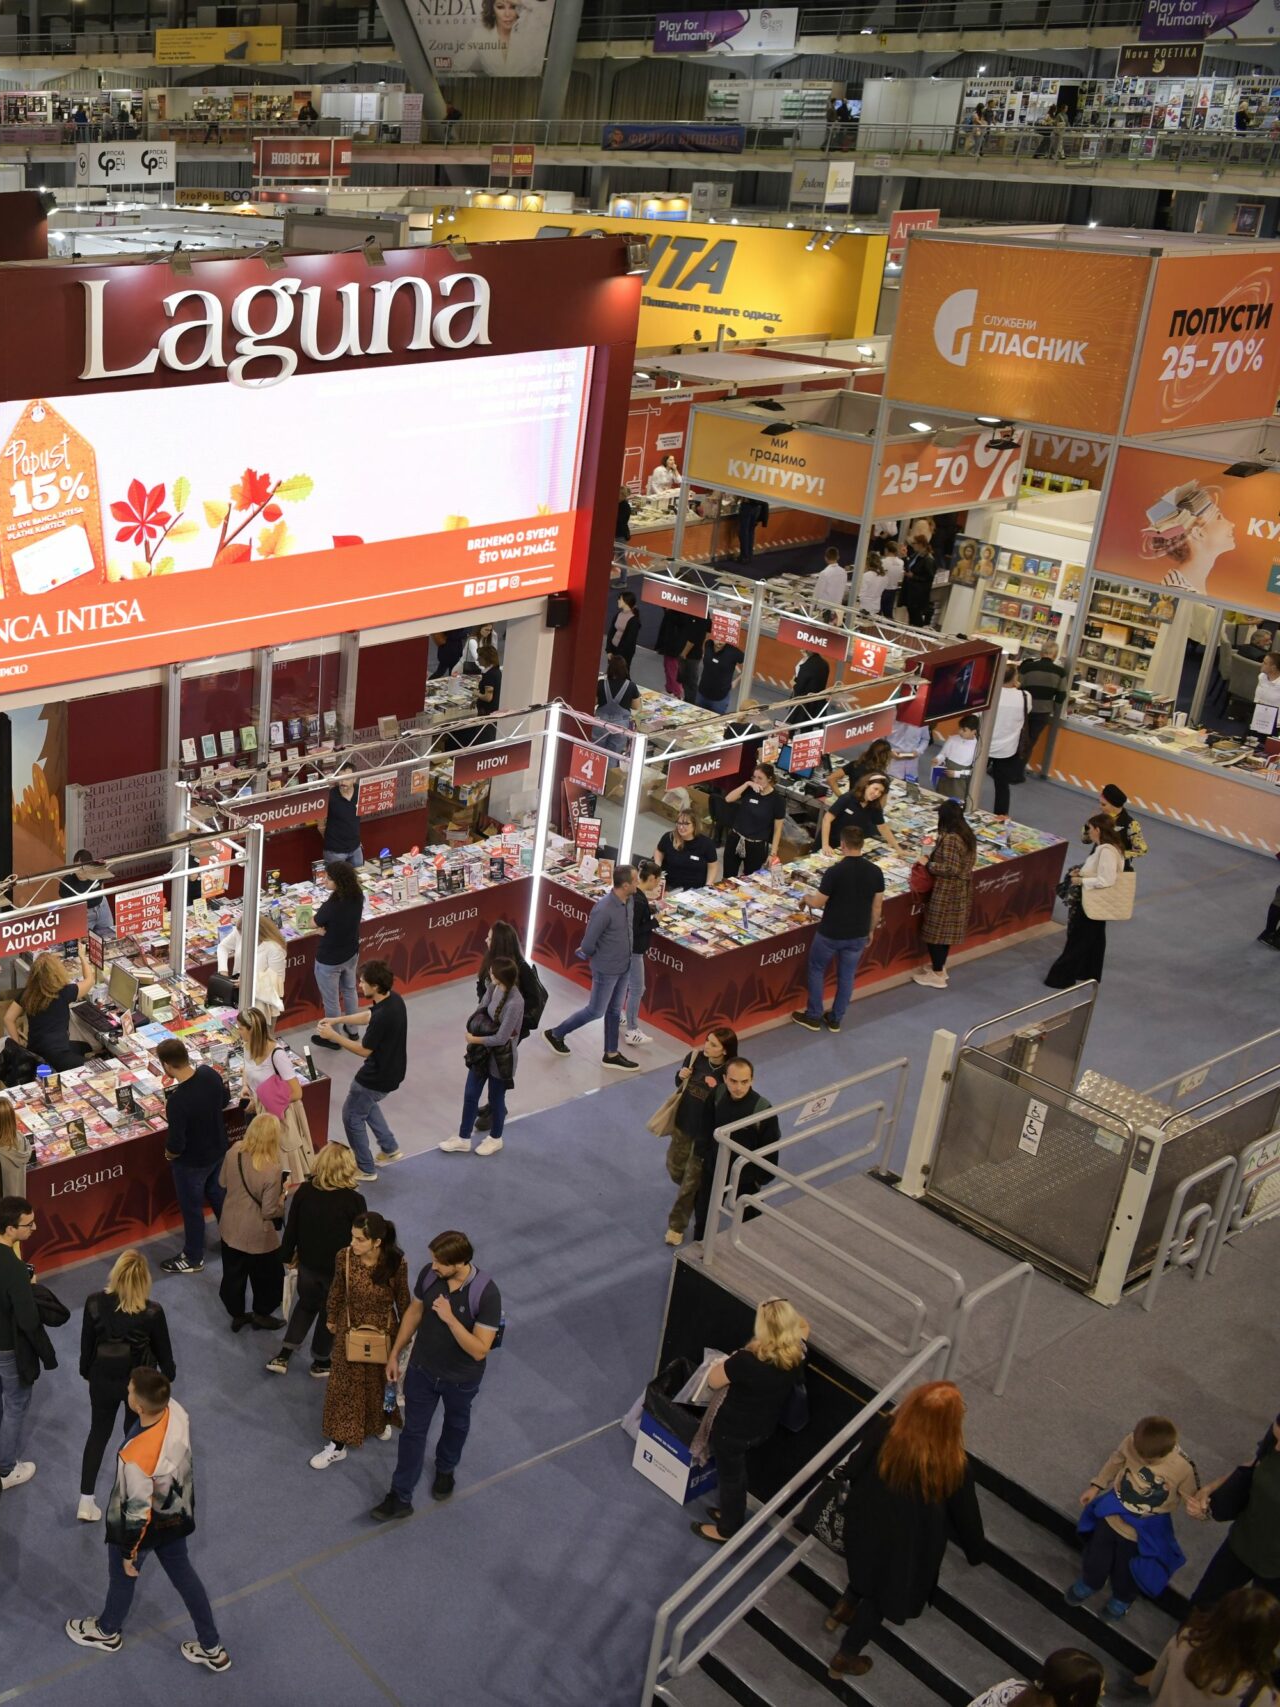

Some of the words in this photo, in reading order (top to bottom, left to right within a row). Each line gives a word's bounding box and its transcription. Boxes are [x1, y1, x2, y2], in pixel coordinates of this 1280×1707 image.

[659, 19, 681, 32] Play
[683, 19, 699, 30] for
[1156, 12, 1217, 28] Humanity
[666, 28, 716, 43] Humanity
[428, 39, 454, 51] Zora
[454, 40, 466, 54] je
[468, 39, 507, 50] svanula
[1125, 49, 1149, 60] Nova
[1153, 47, 1198, 59] POETIKA
[271, 152, 320, 165] НОВОСТИ
[180, 191, 220, 200] ProPolis
[742, 310, 783, 323] одмах.
[983, 314, 1037, 330] СЛУЖБЕНИ
[1168, 302, 1274, 338] ПОПУСТИ
[77, 272, 493, 389] Laguna
[978, 330, 1089, 366] ГЛАСНИК
[770, 437, 789, 450] ми
[4, 432, 71, 480] Popust
[750, 447, 807, 468] градимо
[727, 458, 826, 496] КУЛТУРУ!
[9, 471, 90, 518] 15%
[33, 515, 58, 526] BANCA
[467, 533, 515, 551] BRINEMO
[516, 531, 525, 542] O
[525, 525, 559, 542] SVEMU
[478, 546, 499, 564] ŠTO
[499, 546, 521, 561] VAM
[661, 590, 689, 606] DRAME
[56, 598, 146, 636] INTESA
[796, 630, 829, 648] DRAME
[861, 650, 875, 668] 3
[845, 722, 875, 739] DRAME
[476, 754, 509, 772] HITOVI
[578, 749, 601, 761] KASA
[580, 759, 594, 780] 4
[689, 757, 722, 777] DRAME
[380, 779, 395, 790] 10%
[379, 791, 394, 800] 15%
[377, 801, 393, 811] 20%
[141, 893, 161, 906] 10%
[548, 893, 591, 924] Lagun
[141, 904, 161, 918] 15%
[428, 905, 479, 929] Laguna
[1, 913, 61, 938] DOMAĆI
[141, 917, 162, 931] 20%
[5, 929, 57, 954] AUTORI
[645, 945, 684, 973] aguna
[760, 942, 806, 968] Laguna
[51, 1162, 125, 1198] Laguna
